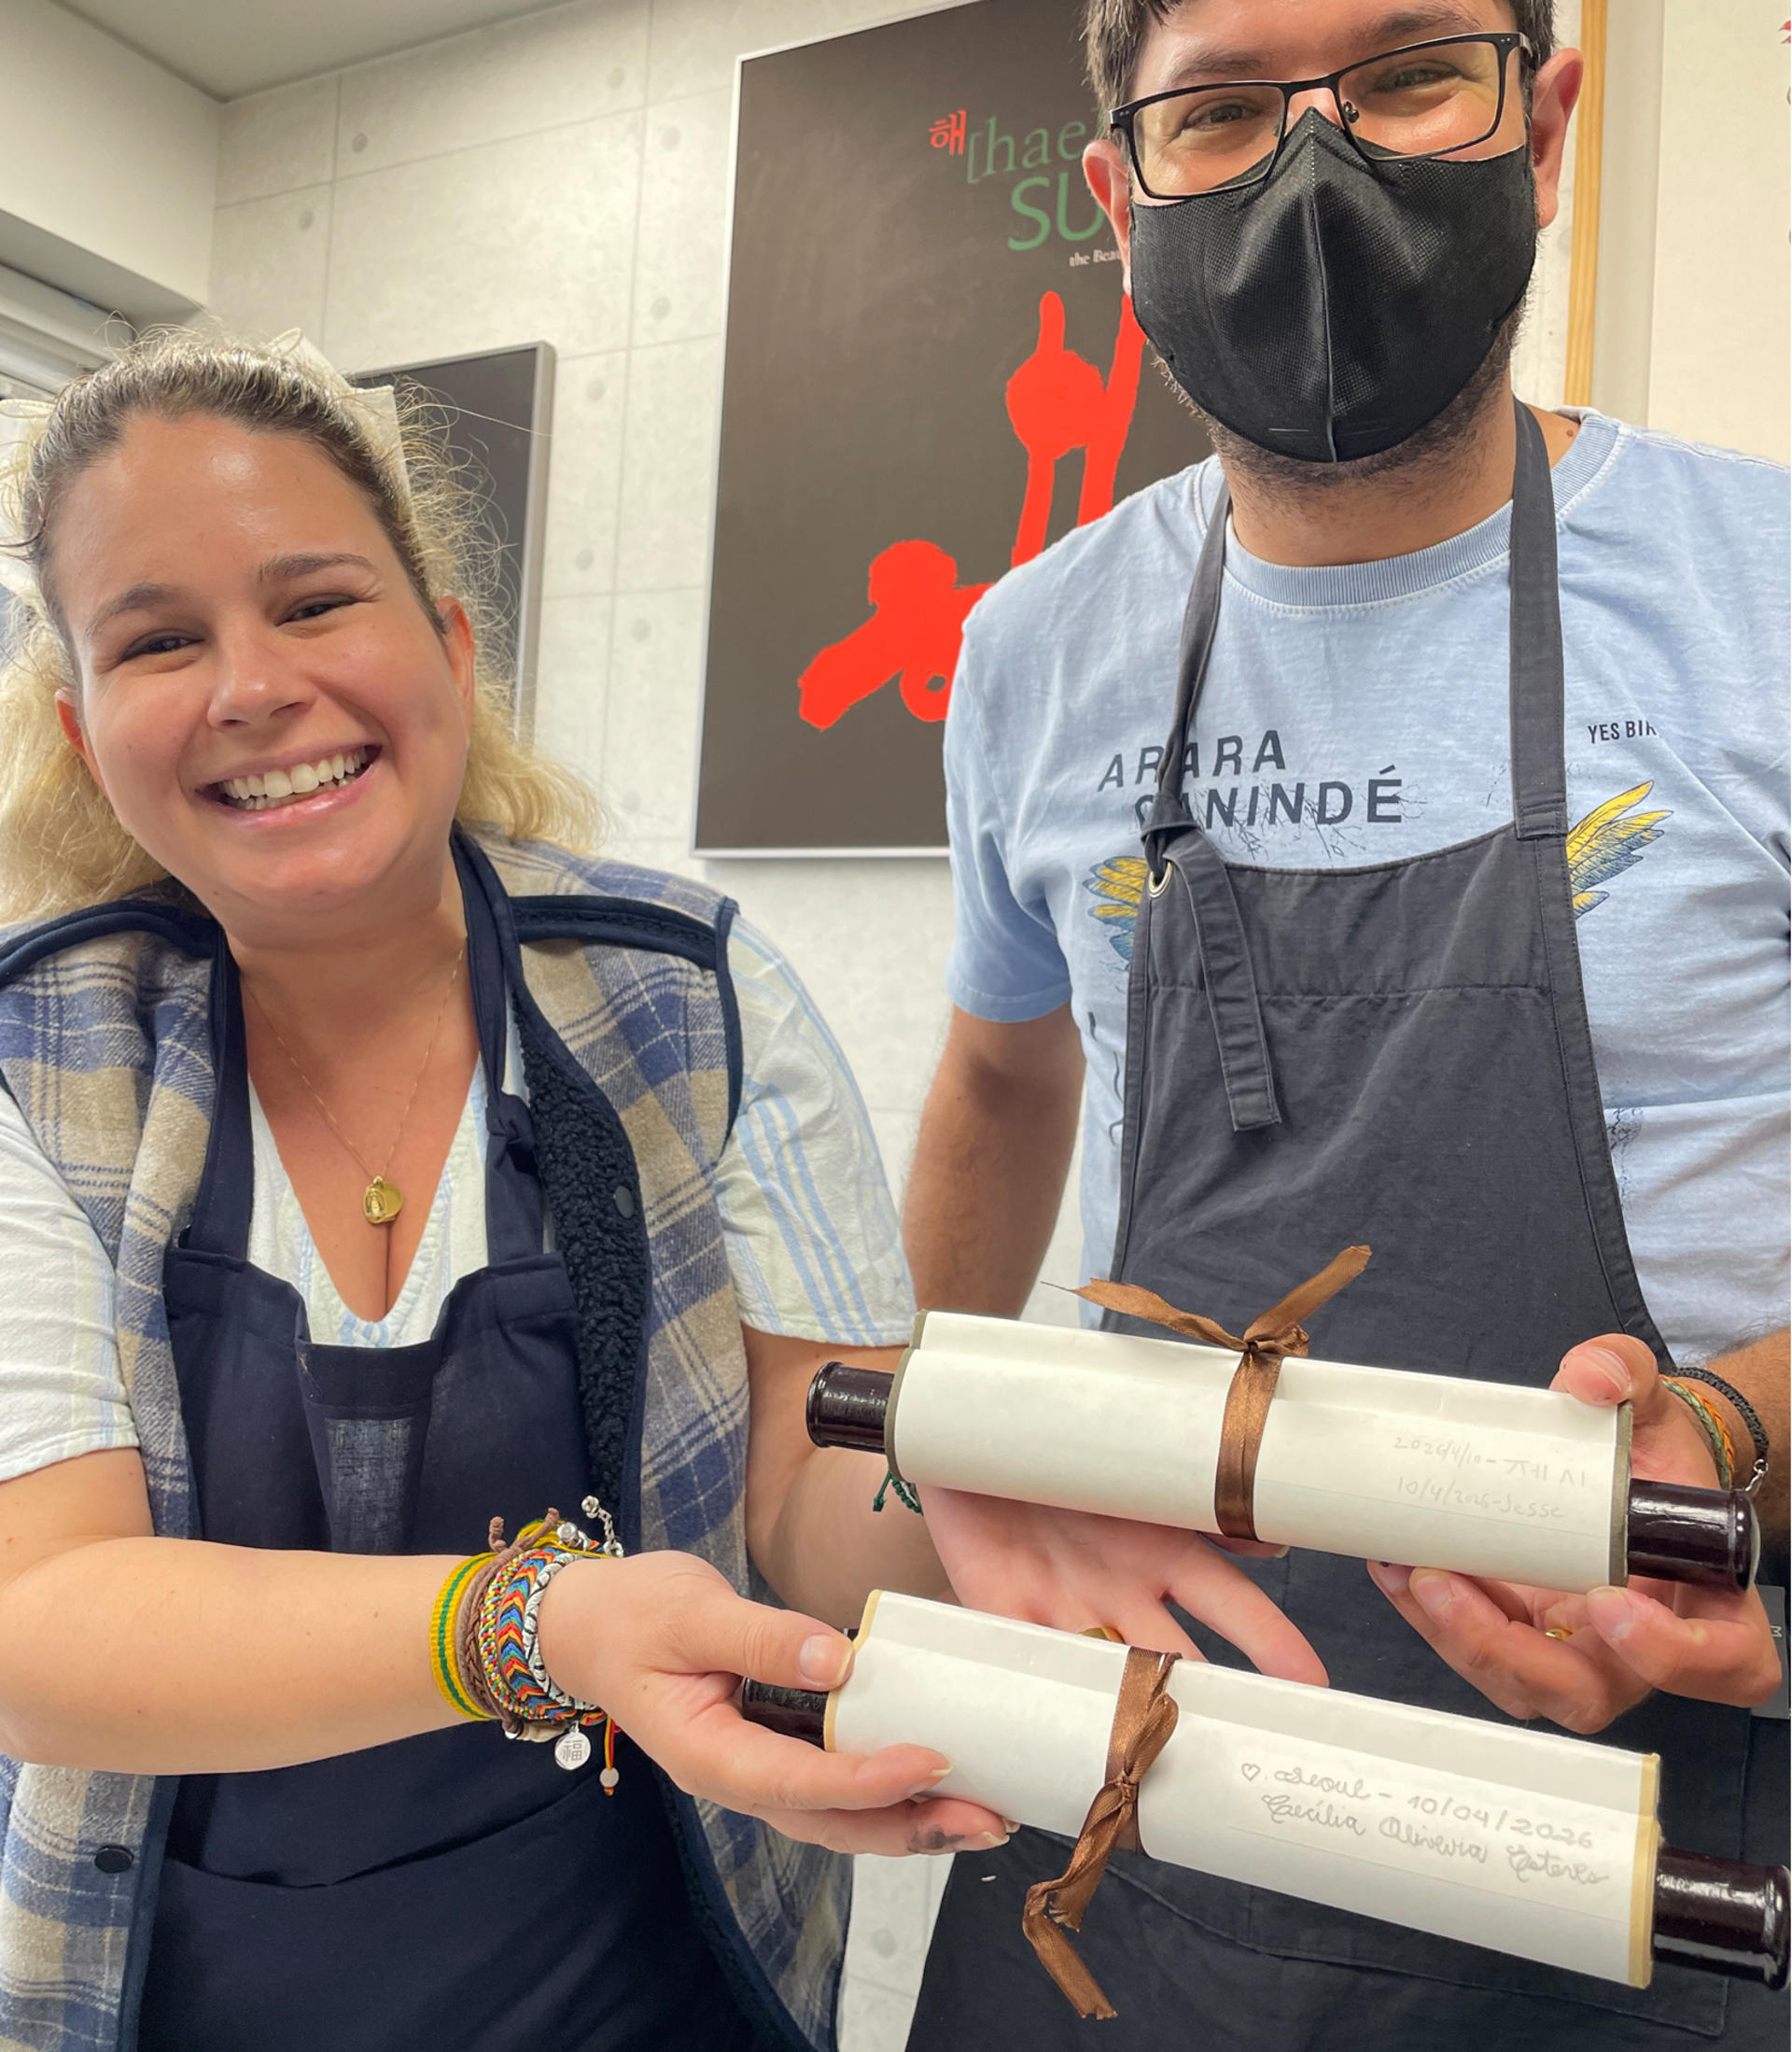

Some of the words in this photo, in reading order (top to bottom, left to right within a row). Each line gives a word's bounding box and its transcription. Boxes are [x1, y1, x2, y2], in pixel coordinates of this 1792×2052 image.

[929, 109, 967, 156] 해
[967, 106, 1099, 184] [hae
[1069, 251, 1091, 267] the
[1588, 722, 1620, 744] YES
[562, 1739, 583, 1763] 福
[1274, 1766, 1371, 1799] Seoul
[1407, 1794, 1594, 1849] 10/04/2026
